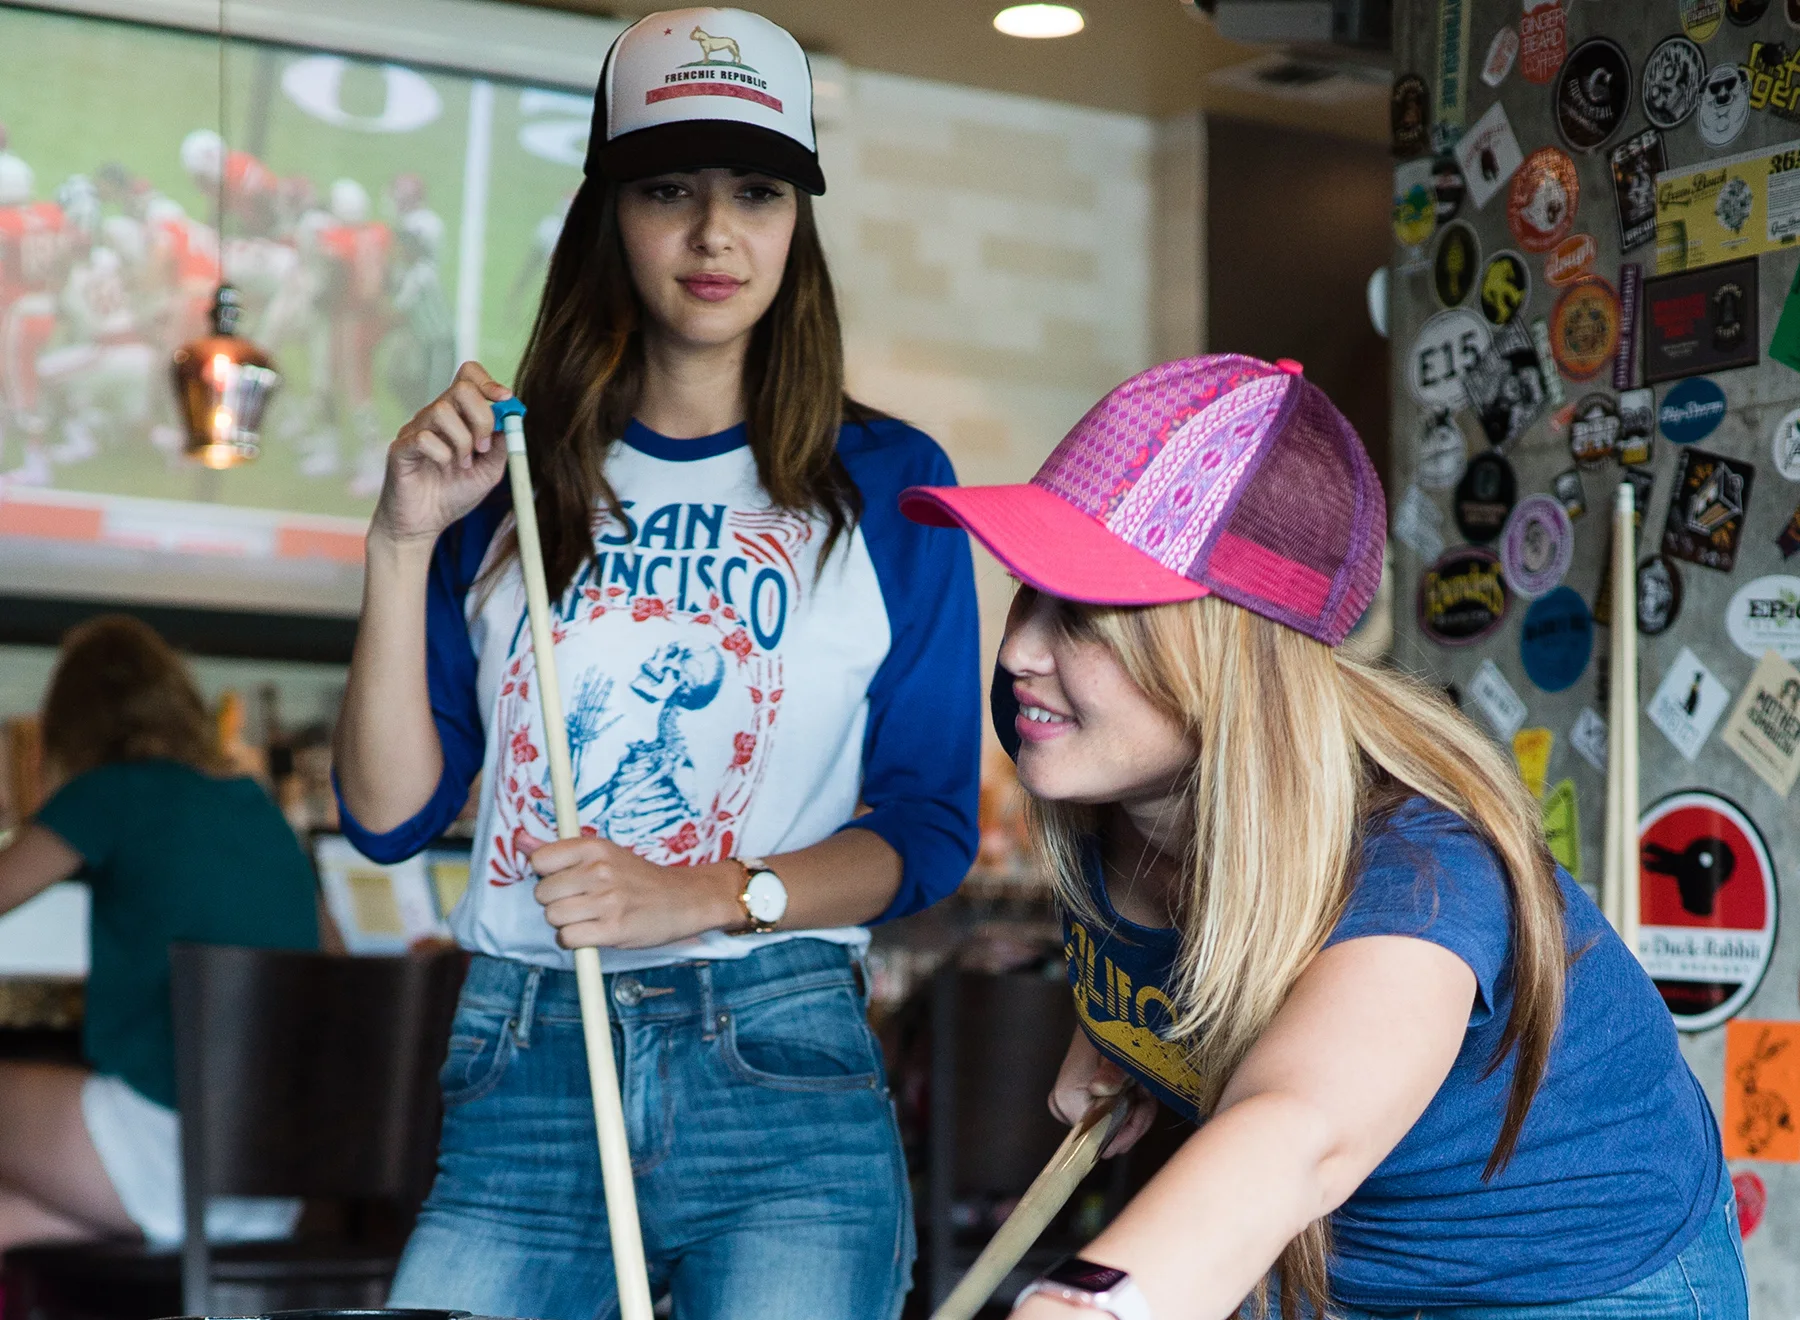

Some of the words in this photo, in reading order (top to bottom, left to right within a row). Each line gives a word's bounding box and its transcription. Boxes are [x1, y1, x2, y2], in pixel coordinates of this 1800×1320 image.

[1521, 7, 1565, 36] GINGER
[1522, 27, 1564, 55] BEARD
[664, 69, 716, 84] FRENCHIE
[720, 70, 768, 90] REPUBLIC
[1419, 329, 1480, 386] E15
[598, 500, 729, 551] SAN
[507, 551, 787, 660] ANCISCO
[1652, 934, 1761, 960] Duck-Rabbit
